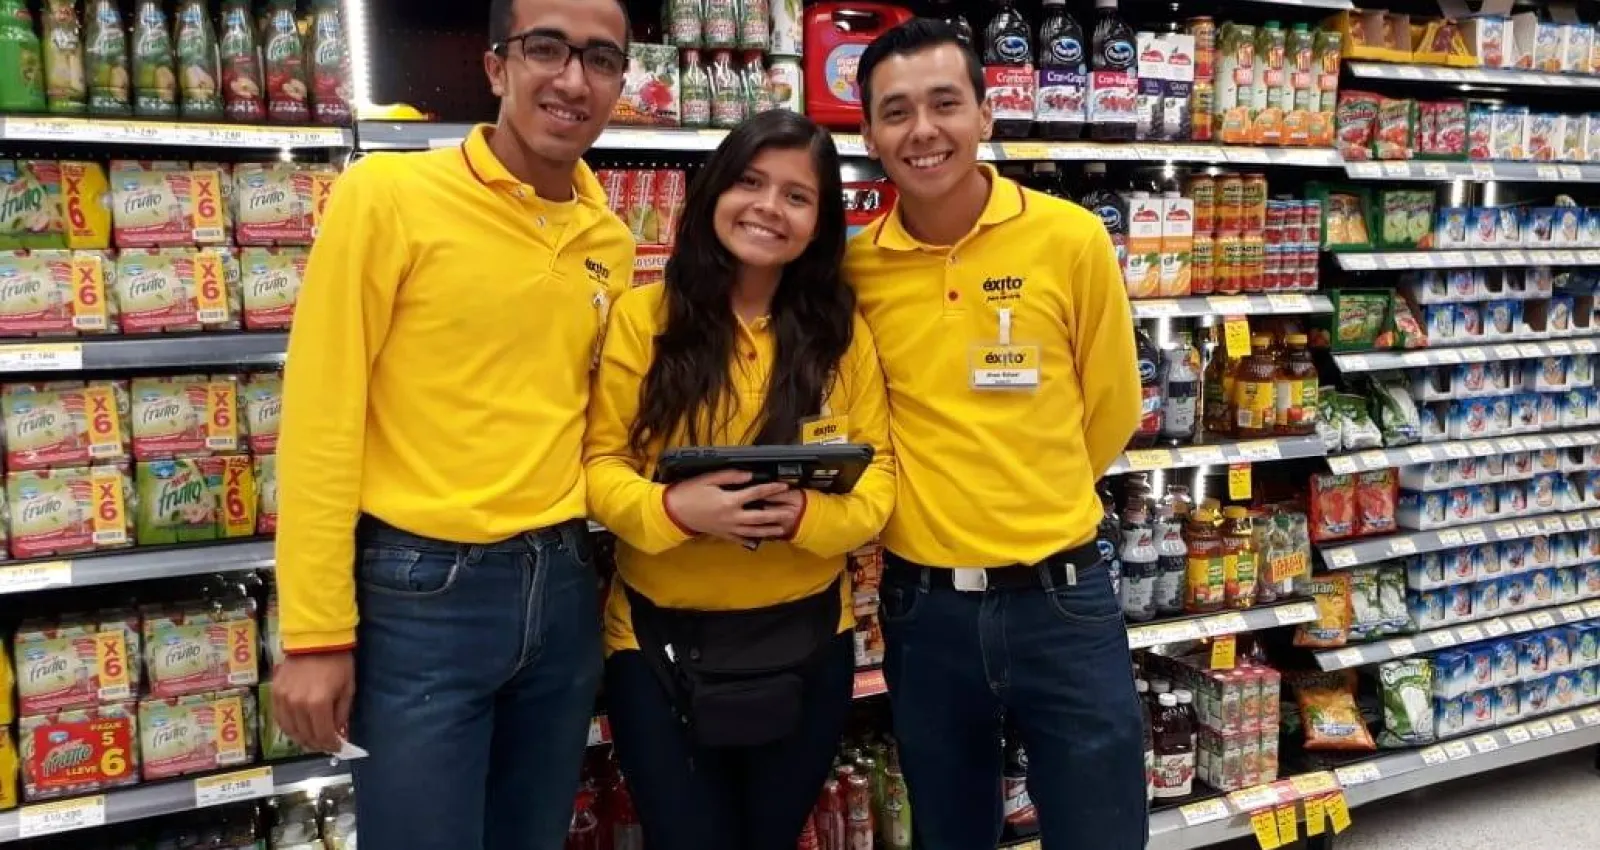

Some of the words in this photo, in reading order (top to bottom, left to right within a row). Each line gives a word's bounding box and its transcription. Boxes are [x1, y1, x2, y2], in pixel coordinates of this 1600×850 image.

[68, 196, 85, 229] 6
[198, 199, 216, 218] 6
[202, 280, 220, 300] 6
[982, 276, 1023, 294] éxito
[78, 285, 97, 306] 6
[94, 413, 112, 434] 6
[213, 408, 231, 428] 6
[99, 500, 119, 521] 6
[226, 487, 245, 518] 6
[234, 645, 250, 663] 6
[104, 658, 122, 679] 6
[101, 731, 115, 745] 5
[221, 723, 238, 742] 6
[101, 747, 126, 776] 6
